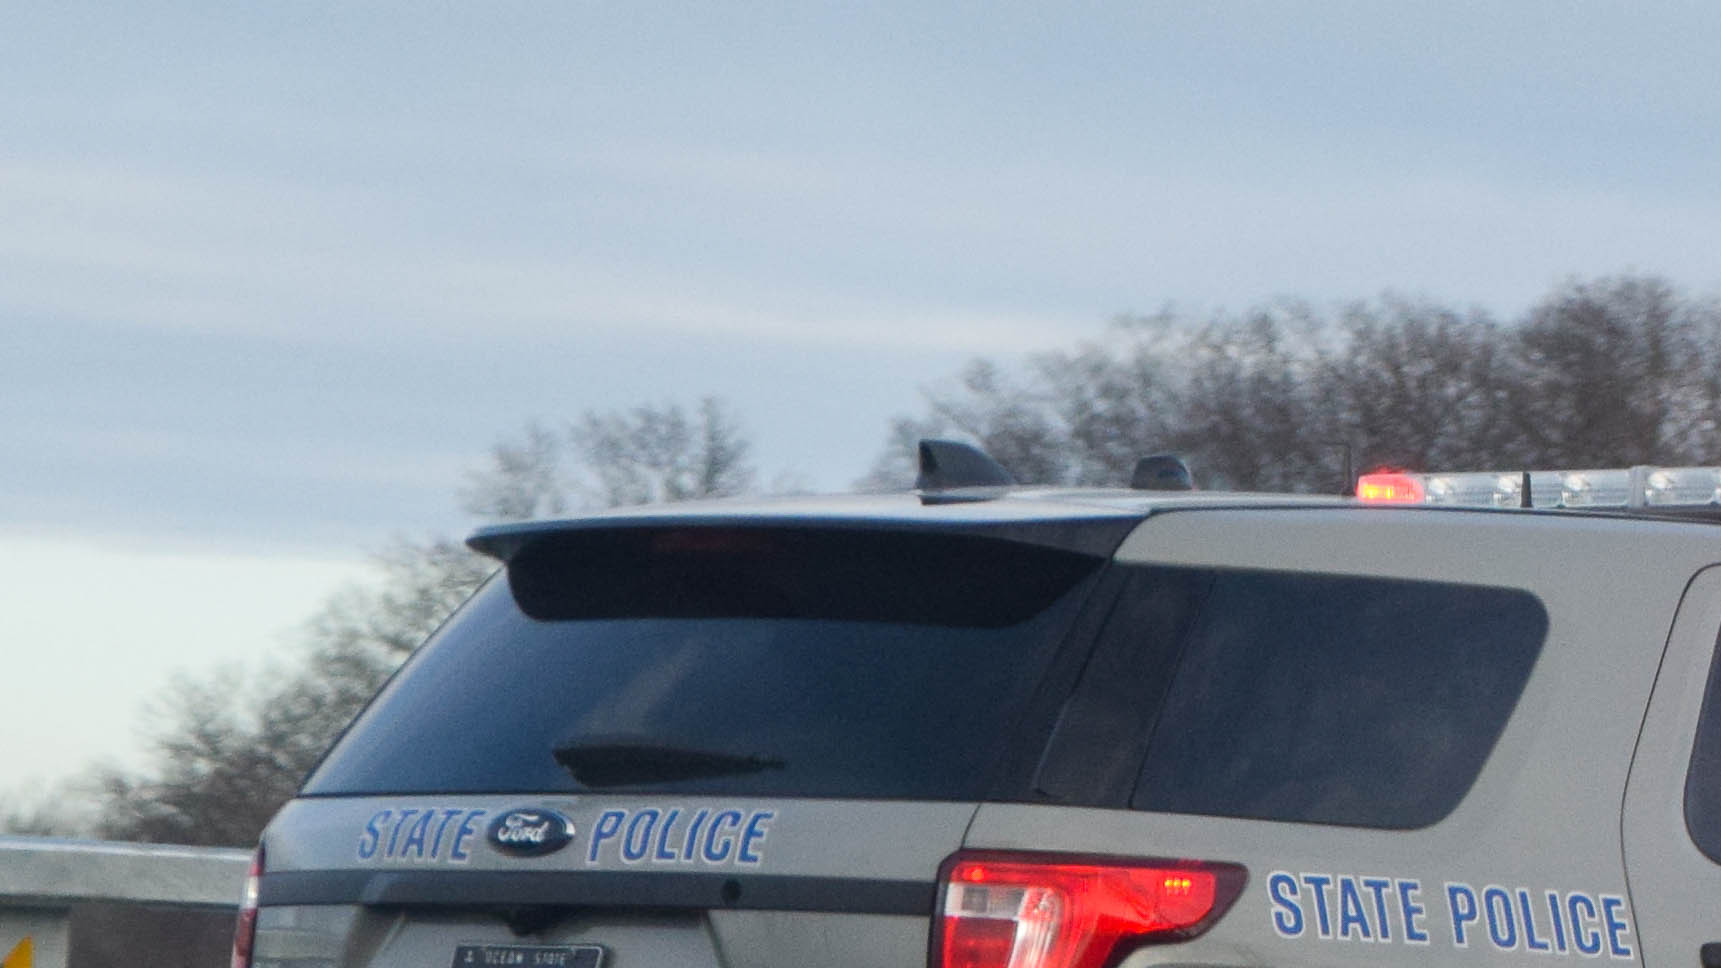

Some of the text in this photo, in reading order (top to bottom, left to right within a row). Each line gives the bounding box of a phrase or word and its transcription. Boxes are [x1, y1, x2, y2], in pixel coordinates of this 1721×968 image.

[358, 806, 777, 866] STATE POLICE
[498, 814, 549, 843] Ford
[1267, 870, 1634, 960] STATE POLICE
